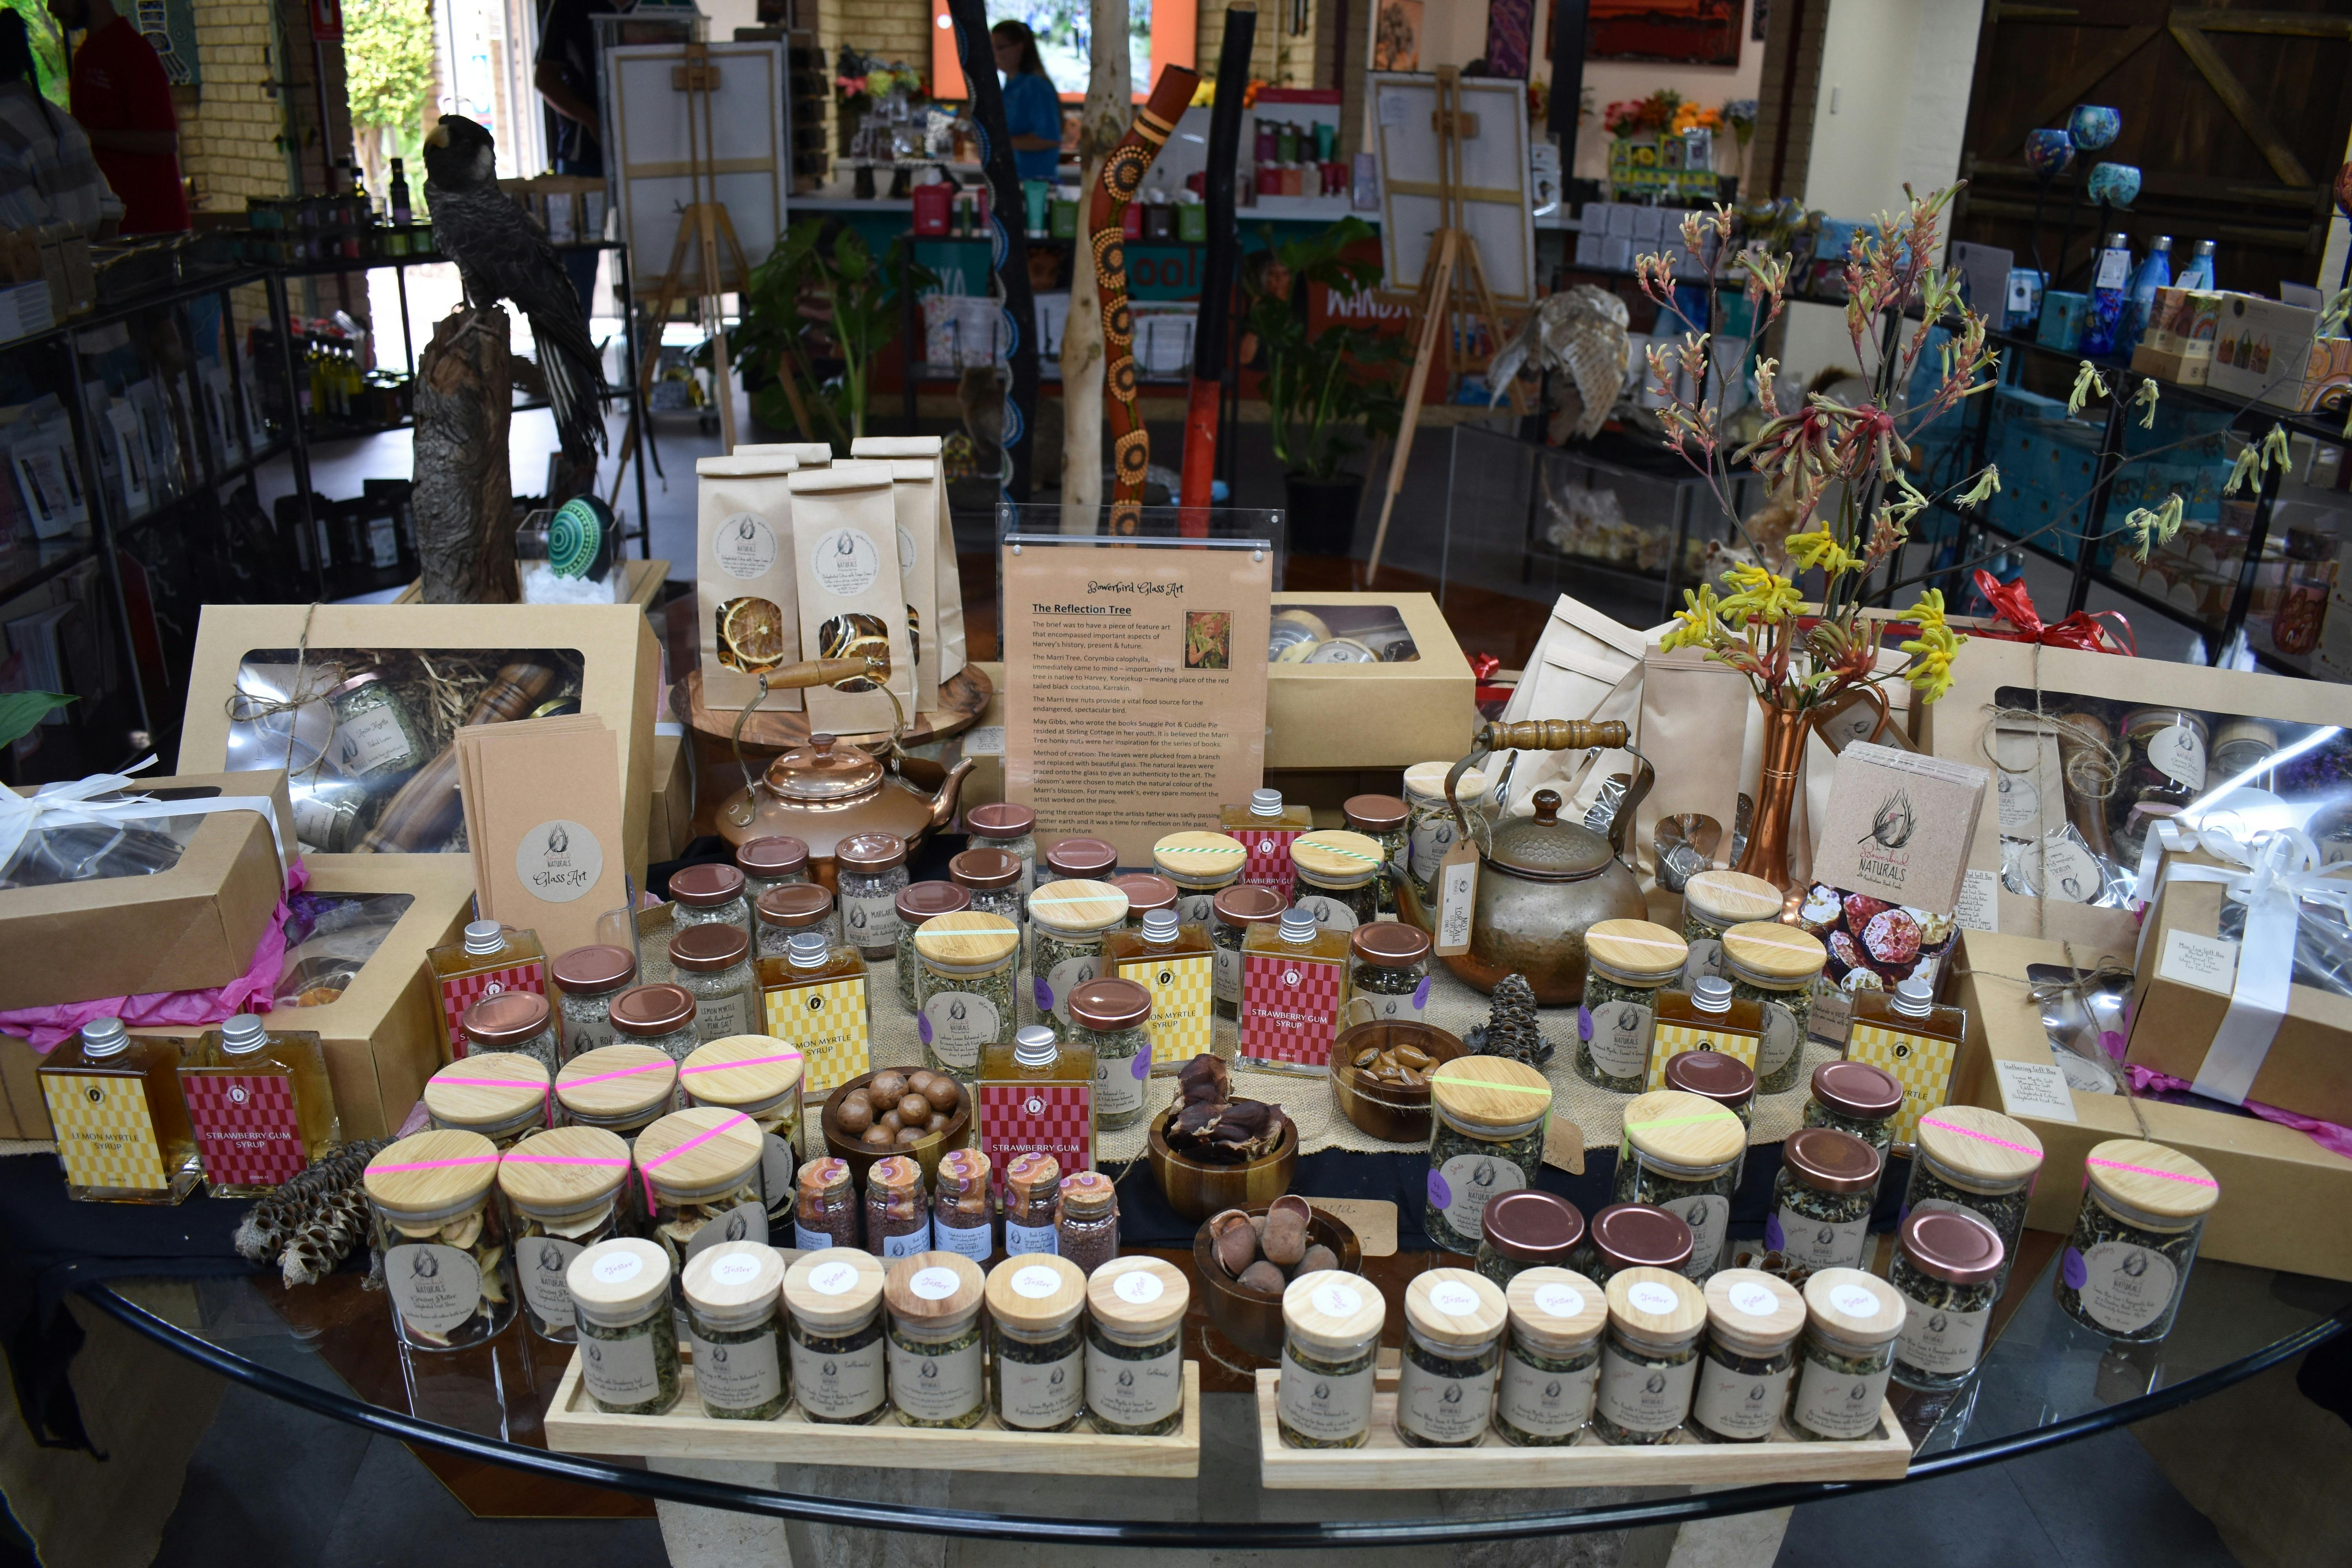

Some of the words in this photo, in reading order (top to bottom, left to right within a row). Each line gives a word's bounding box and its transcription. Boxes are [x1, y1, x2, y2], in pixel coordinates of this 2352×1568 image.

[1087, 581, 1135, 594] Bowerbird
[1137, 581, 1165, 596] Glass
[1165, 583, 1184, 598] Art
[1032, 603, 1051, 612] The
[1054, 604, 1105, 613] Reflection
[1108, 605, 1131, 613] Tree
[372, 719, 388, 730] Myrtle
[1860, 842, 1909, 866] Bowerbird
[1859, 858, 1906, 881] NATURALS
[533, 871, 565, 887] Glass
[567, 870, 586, 887] Art
[1863, 875, 1881, 884] Australian
[871, 907, 895, 918] MARGARIT
[1281, 968, 1293, 984] Melbourne
[1294, 969, 1303, 986] Bushfood
[804, 994, 816, 1012] Melbourne
[817, 993, 828, 1009] Bushfood
[718, 1004, 735, 1013] MYRTLE
[1165, 1010, 1196, 1019] MYRTLE
[1252, 1009, 1306, 1021] STRAWBERRY
[722, 1020, 732, 1028] SALT
[1153, 1020, 1178, 1029] SYRUP
[1276, 1020, 1302, 1029] SYRUP
[819, 1034, 851, 1045] MYRTLE
[806, 1046, 833, 1056] SYRUP
[2004, 1063, 2031, 1073] Gathering
[1022, 1096, 1036, 1114] Melbourne
[1036, 1095, 1048, 1114] Bushfood
